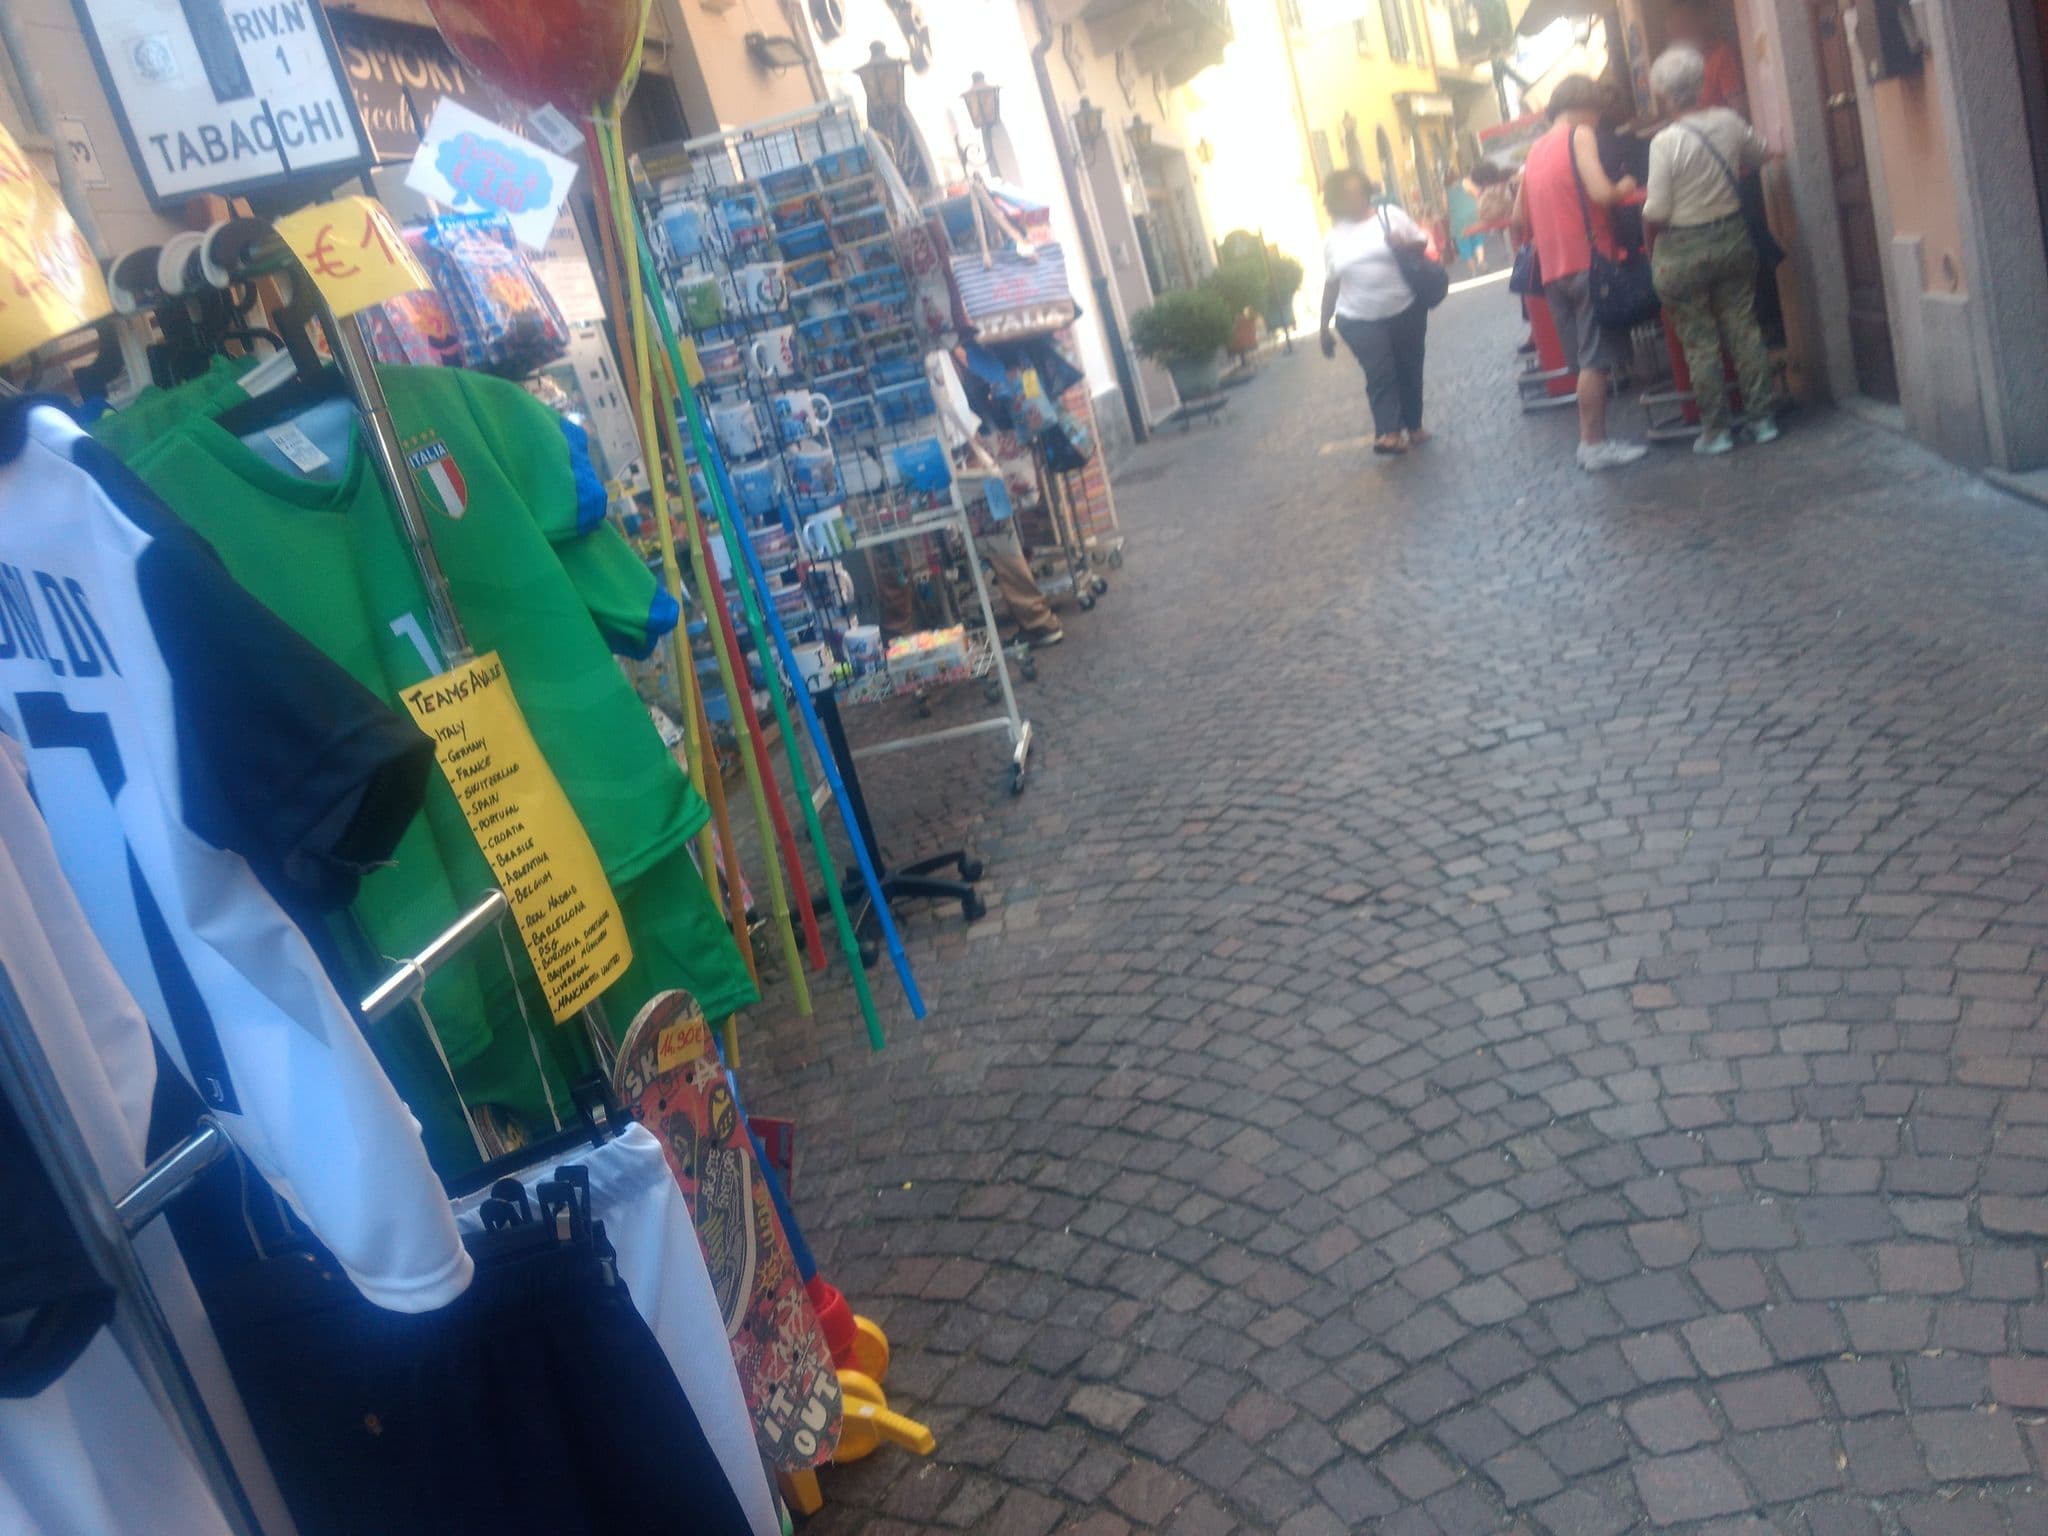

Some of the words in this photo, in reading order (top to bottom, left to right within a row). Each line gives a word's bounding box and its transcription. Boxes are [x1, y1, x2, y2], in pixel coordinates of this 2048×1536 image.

[232, 0, 305, 43] RIV.N
[274, 45, 291, 76] 1
[149, 99, 344, 173] TABACCHI
[408, 443, 447, 469] ITALIA
[408, 679, 469, 715] TEAMS
[434, 720, 467, 742] ITALY
[447, 737, 488, 763] GERMANY
[455, 754, 491, 781] FRANCE
[471, 791, 500, 816] SPAIN
[478, 803, 520, 831] PORTUGAL
[487, 822, 525, 849] CROATIA
[514, 869, 553, 904] BELGIUM
[525, 909, 546, 928] REAL
[538, 938, 559, 959] PSG
[763, 1384, 794, 1443] IT
[793, 1371, 839, 1456] OUT
